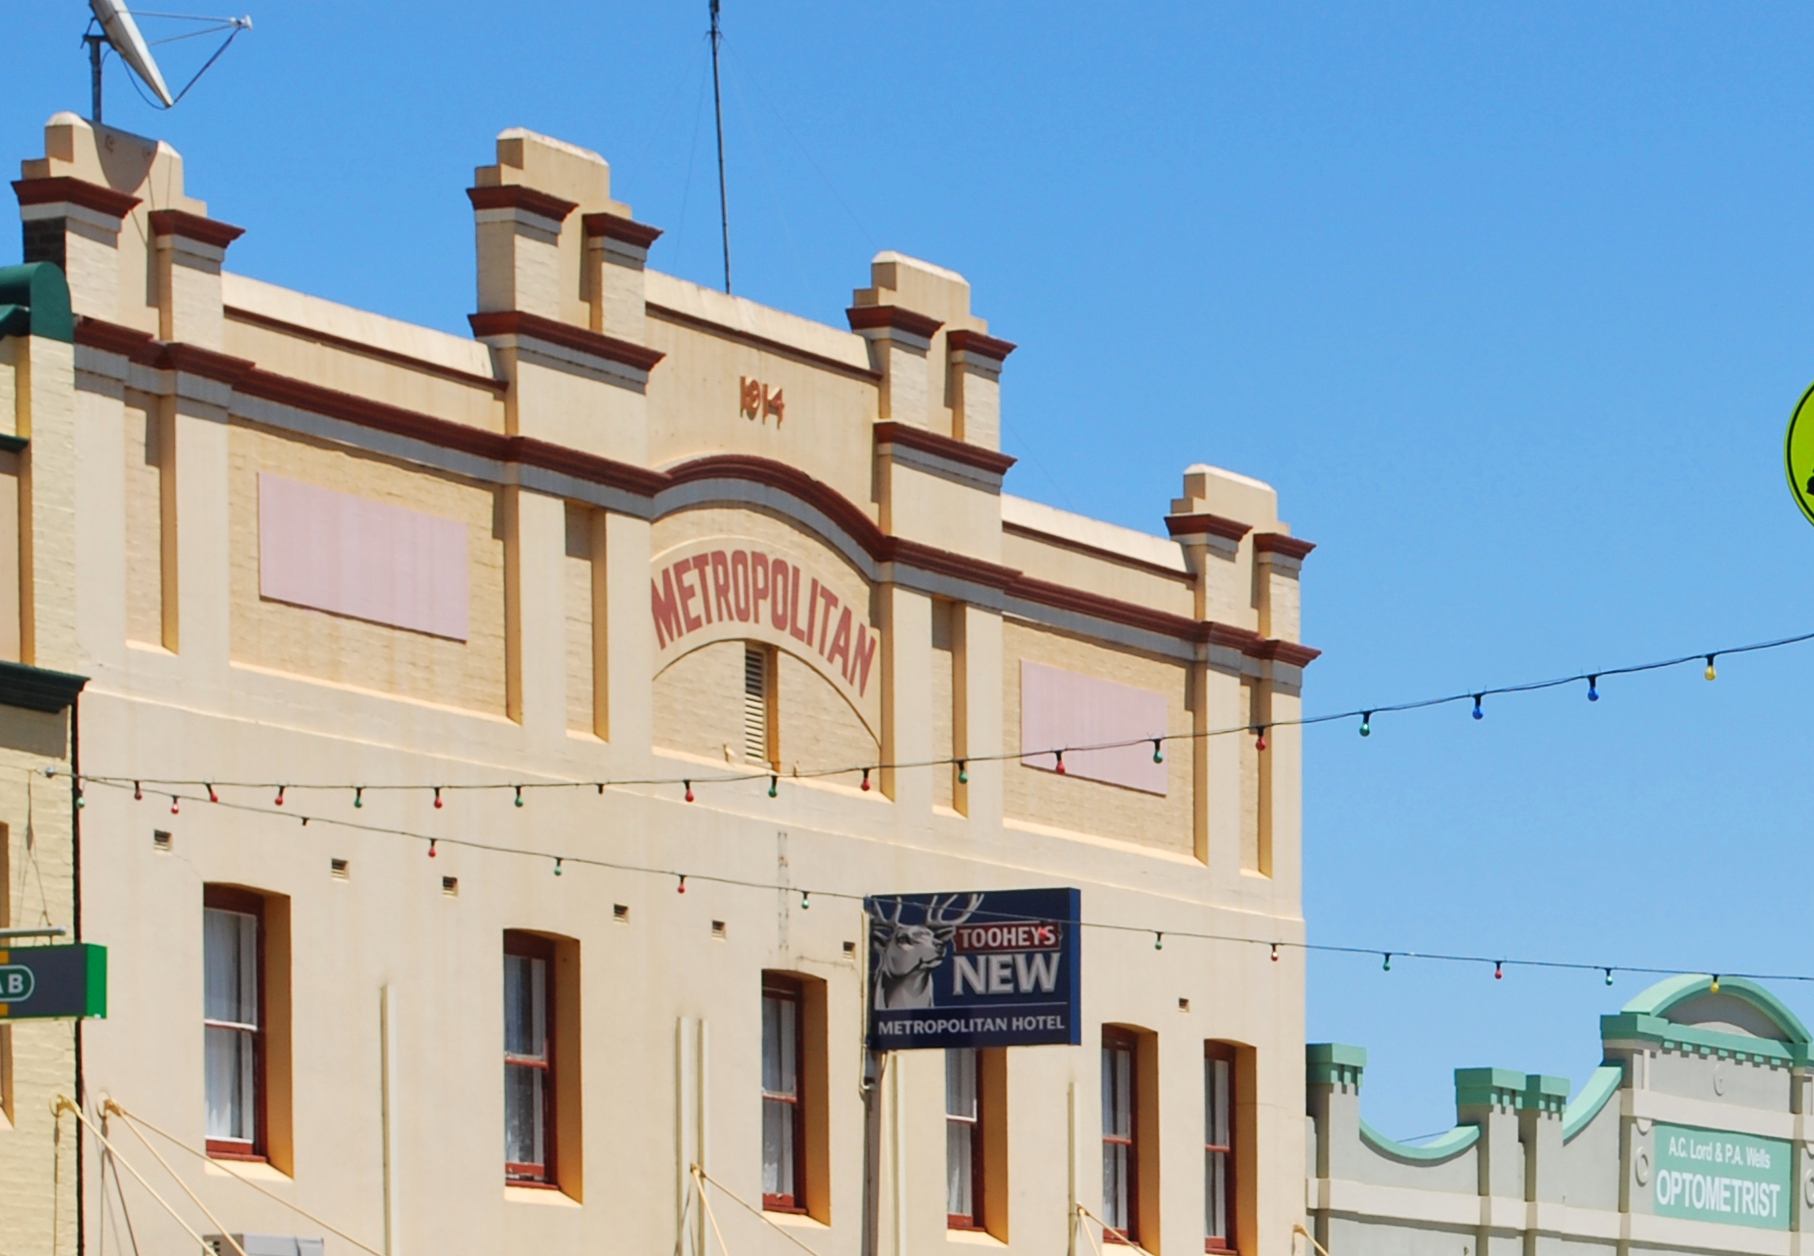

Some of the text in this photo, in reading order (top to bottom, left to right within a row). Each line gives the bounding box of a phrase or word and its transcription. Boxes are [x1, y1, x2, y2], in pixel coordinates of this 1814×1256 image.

[740, 375, 785, 427] 1914
[651, 549, 876, 697] METROPOLITAN
[957, 923, 1058, 950] TOOHEYS
[0, 973, 24, 994] B
[952, 951, 1061, 996] NEW
[877, 1012, 1065, 1037] METROPOLITAN HOTEL
[1668, 1136, 1771, 1169] A.C. Lord & P.A. Wells
[1656, 1169, 1780, 1218] OPTOMETRIST
